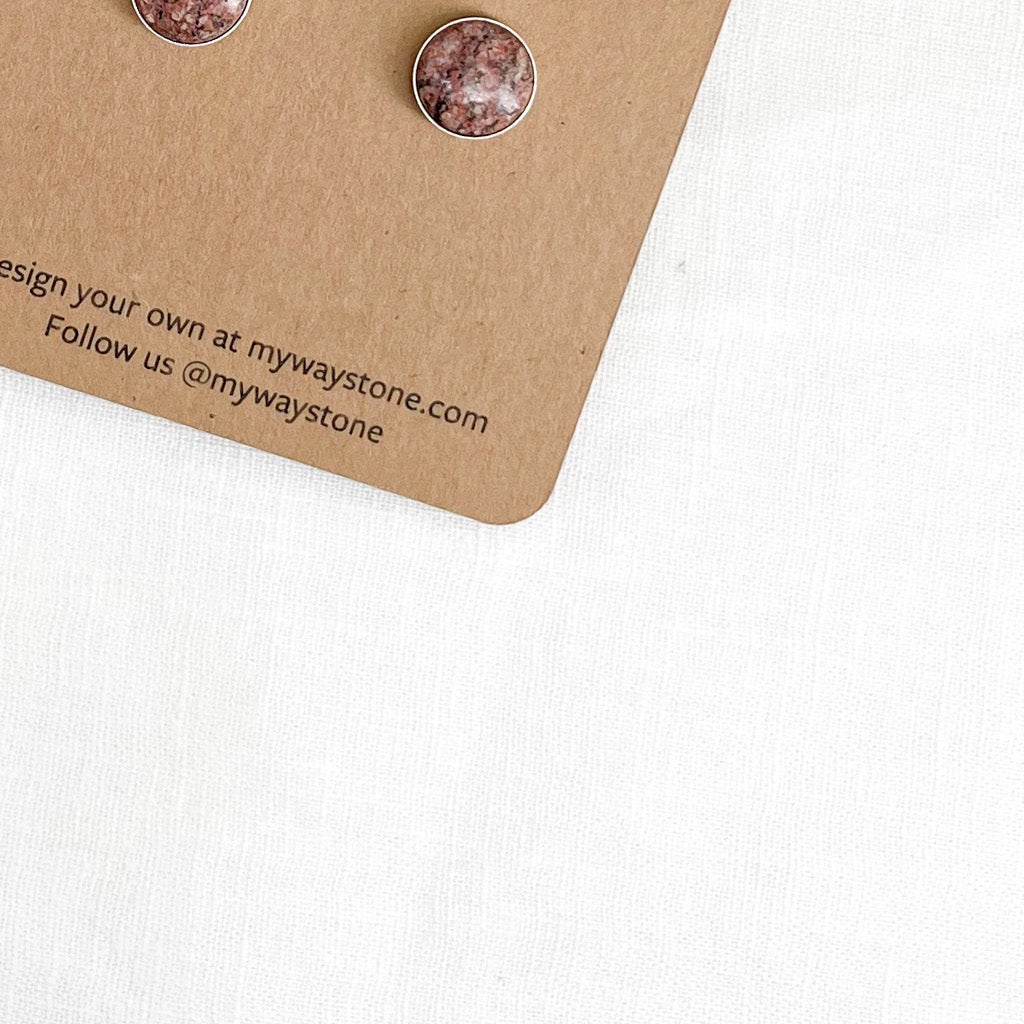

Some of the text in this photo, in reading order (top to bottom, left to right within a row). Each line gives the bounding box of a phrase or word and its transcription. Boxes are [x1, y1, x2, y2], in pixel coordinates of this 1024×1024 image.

[44, 313, 384, 444] Follow us @mywaystone
[69, 282, 142, 319] your
[146, 307, 206, 341] own
[212, 329, 242, 354] at
[247, 340, 489, 434] mywaystone.com
